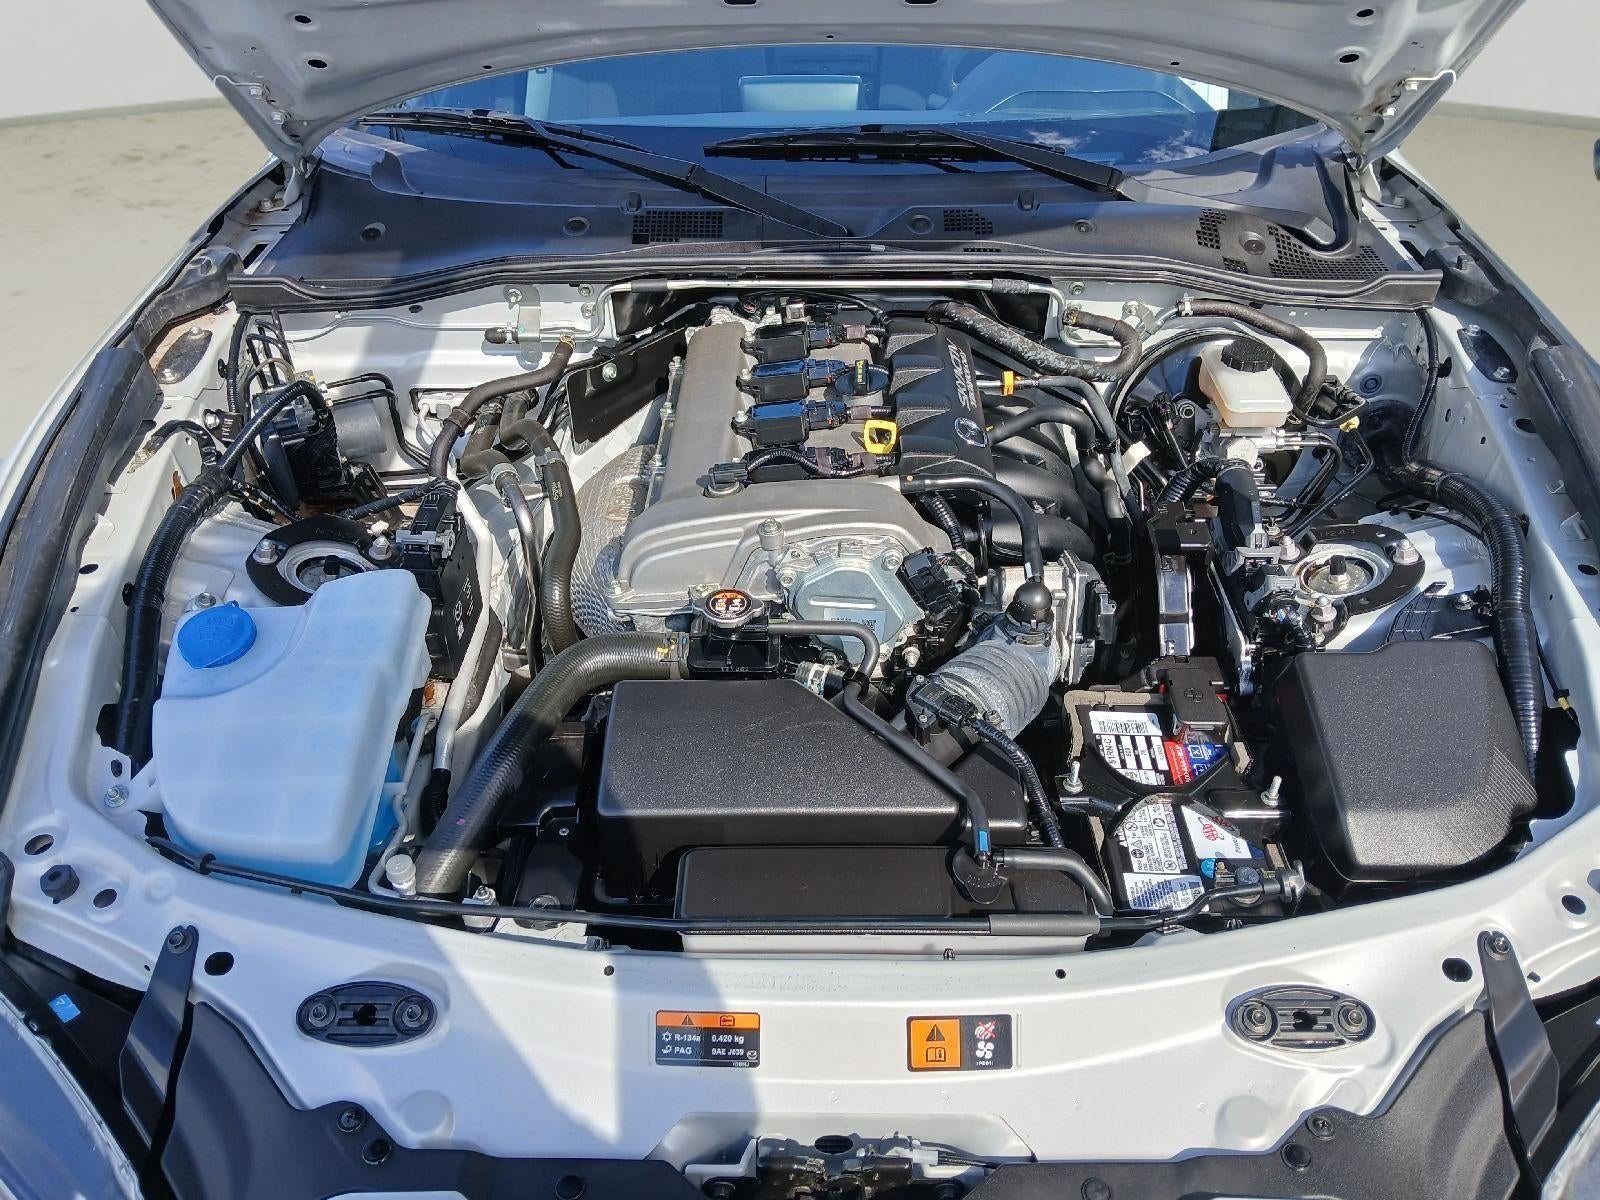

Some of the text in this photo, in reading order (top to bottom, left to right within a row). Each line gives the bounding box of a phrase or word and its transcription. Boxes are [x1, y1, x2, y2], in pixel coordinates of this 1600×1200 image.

[674, 1033, 745, 1045] R-134a 0.420 kg
[674, 1046, 692, 1055] PAG
[711, 1047, 726, 1056] SAE
